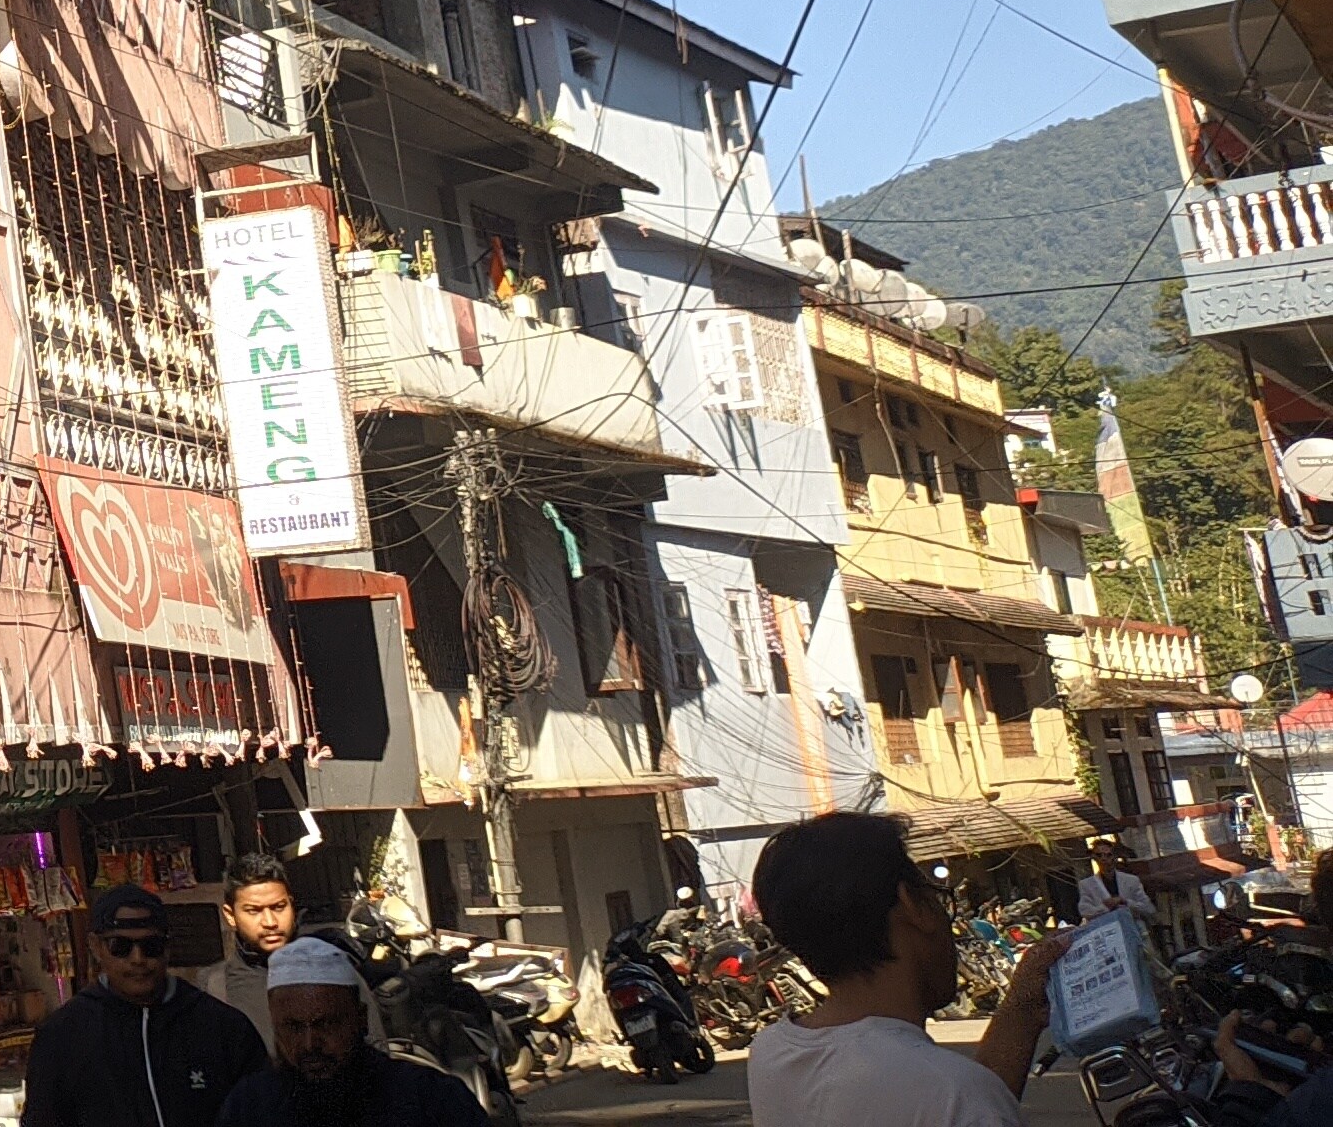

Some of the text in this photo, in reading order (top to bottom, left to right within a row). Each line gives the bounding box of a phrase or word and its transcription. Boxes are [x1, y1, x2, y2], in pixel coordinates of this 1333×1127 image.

[214, 220, 304, 250] HOTEL
[242, 269, 317, 484] KAMENG
[249, 510, 350, 536] RESTAURANT
